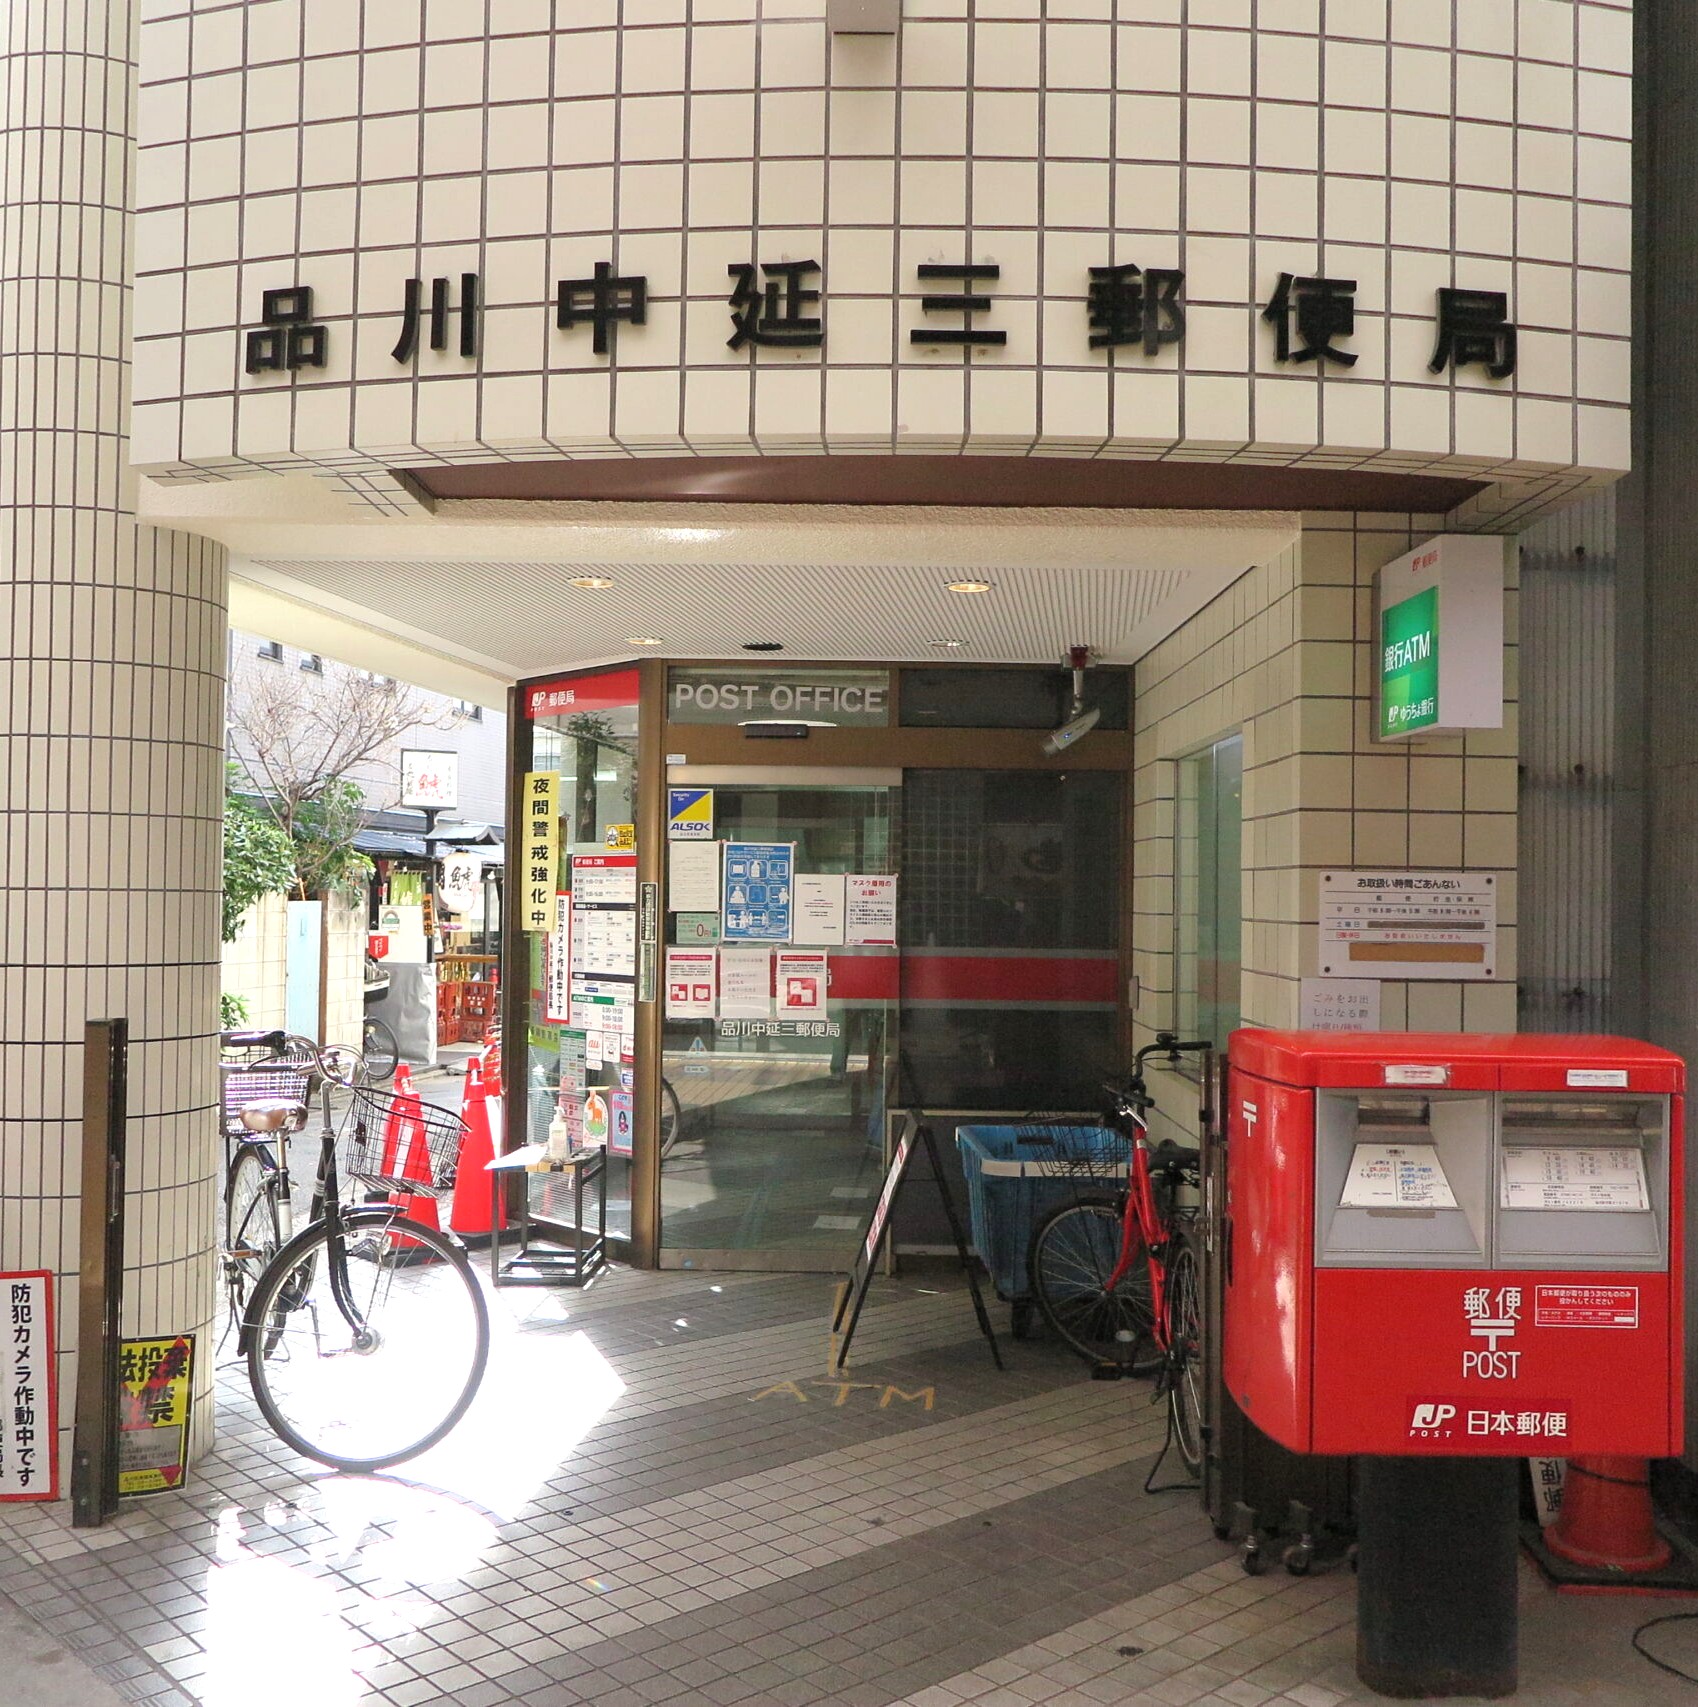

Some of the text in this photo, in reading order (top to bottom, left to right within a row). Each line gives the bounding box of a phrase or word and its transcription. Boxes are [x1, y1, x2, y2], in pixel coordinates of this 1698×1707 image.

[246, 259, 1517, 378] 品川中延三郵便局
[1385, 631, 1430, 673] 銀行ATM
[549, 690, 575, 707] 郵便局
[675, 684, 883, 713] POST OFFICE
[1400, 697, 1434, 721] ゆうちょ銀行
[670, 822, 710, 831] ALSOK
[531, 778, 550, 925] 夜間警戒強化中
[1357, 878, 1460, 889] お取扱い時間ごあんない
[721, 1021, 840, 1037] 品川中延三郵便局
[1464, 1287, 1521, 1319] 郵便
[1463, 1351, 1521, 1379] POST
[11, 1283, 35, 1486] 防犯カメラ作動中です
[747, 1381, 935, 1410] ATM
[1467, 1410, 1567, 1437] 日本郵便
